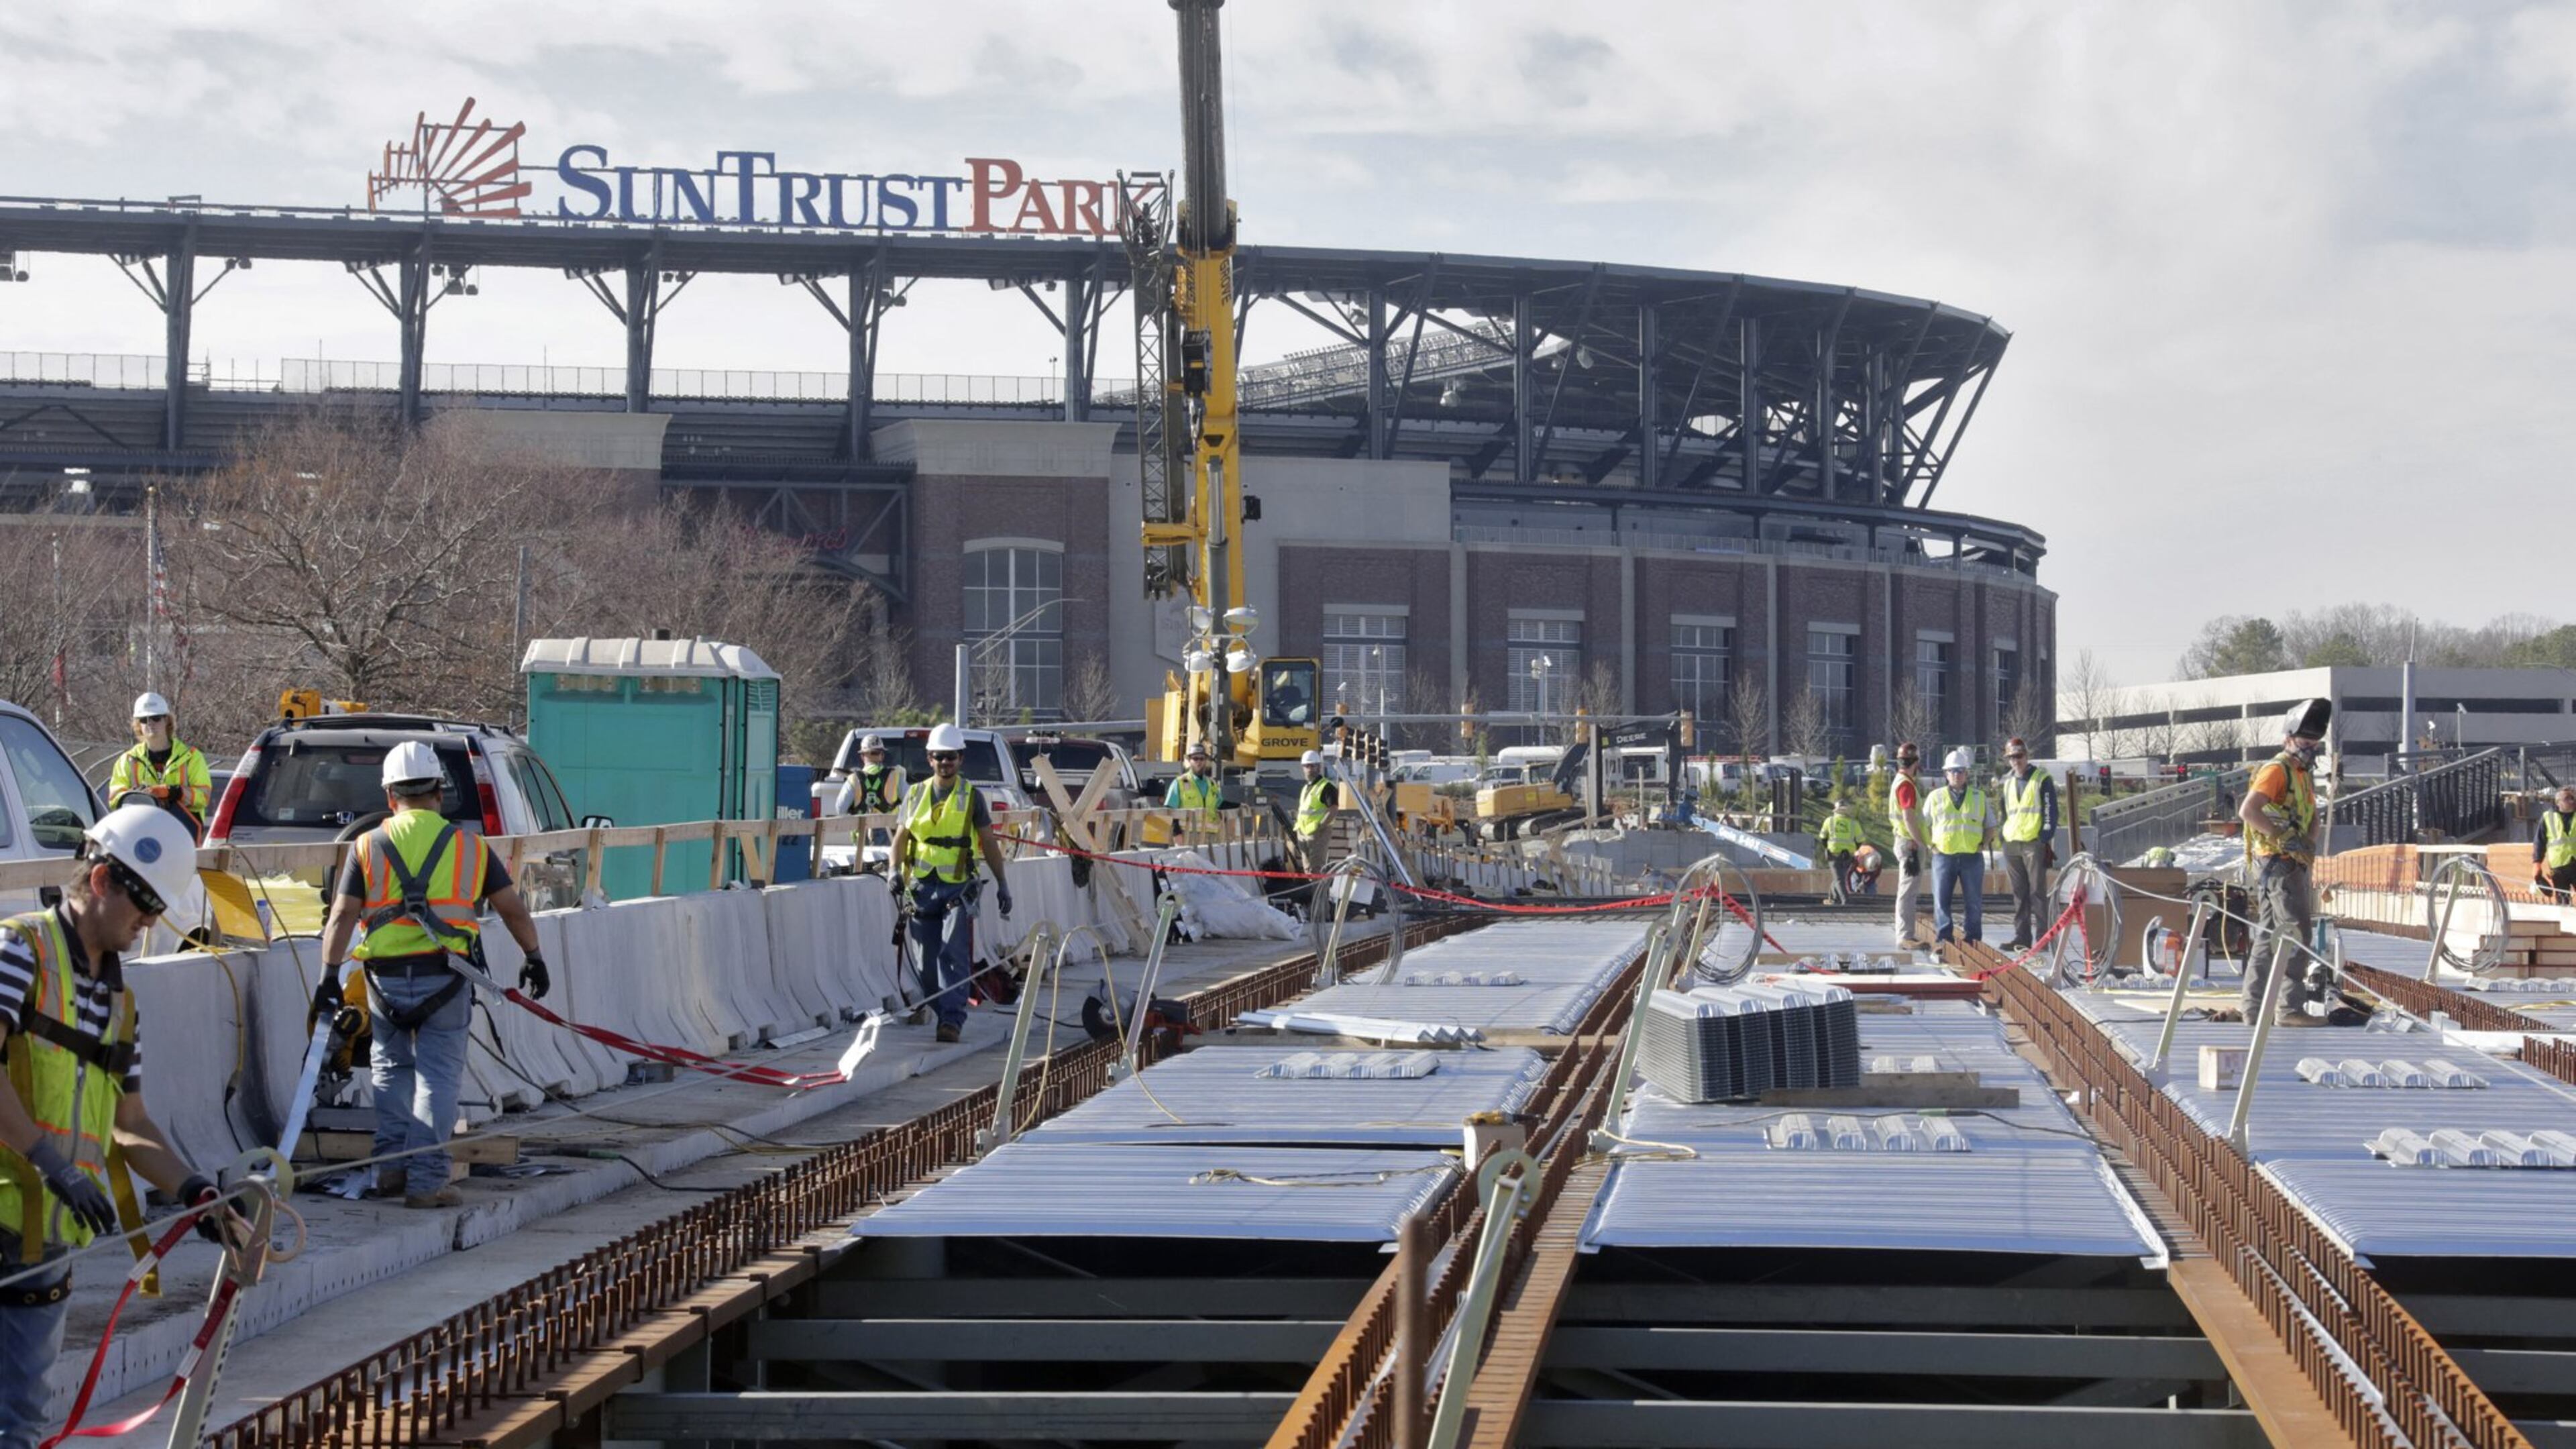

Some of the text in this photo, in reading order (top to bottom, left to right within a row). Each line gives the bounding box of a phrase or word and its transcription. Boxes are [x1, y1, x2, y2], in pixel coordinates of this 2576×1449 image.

[1261, 738, 1309, 747] GROVE
[1615, 733, 1647, 744] DEERE
[777, 806, 804, 820] iller
